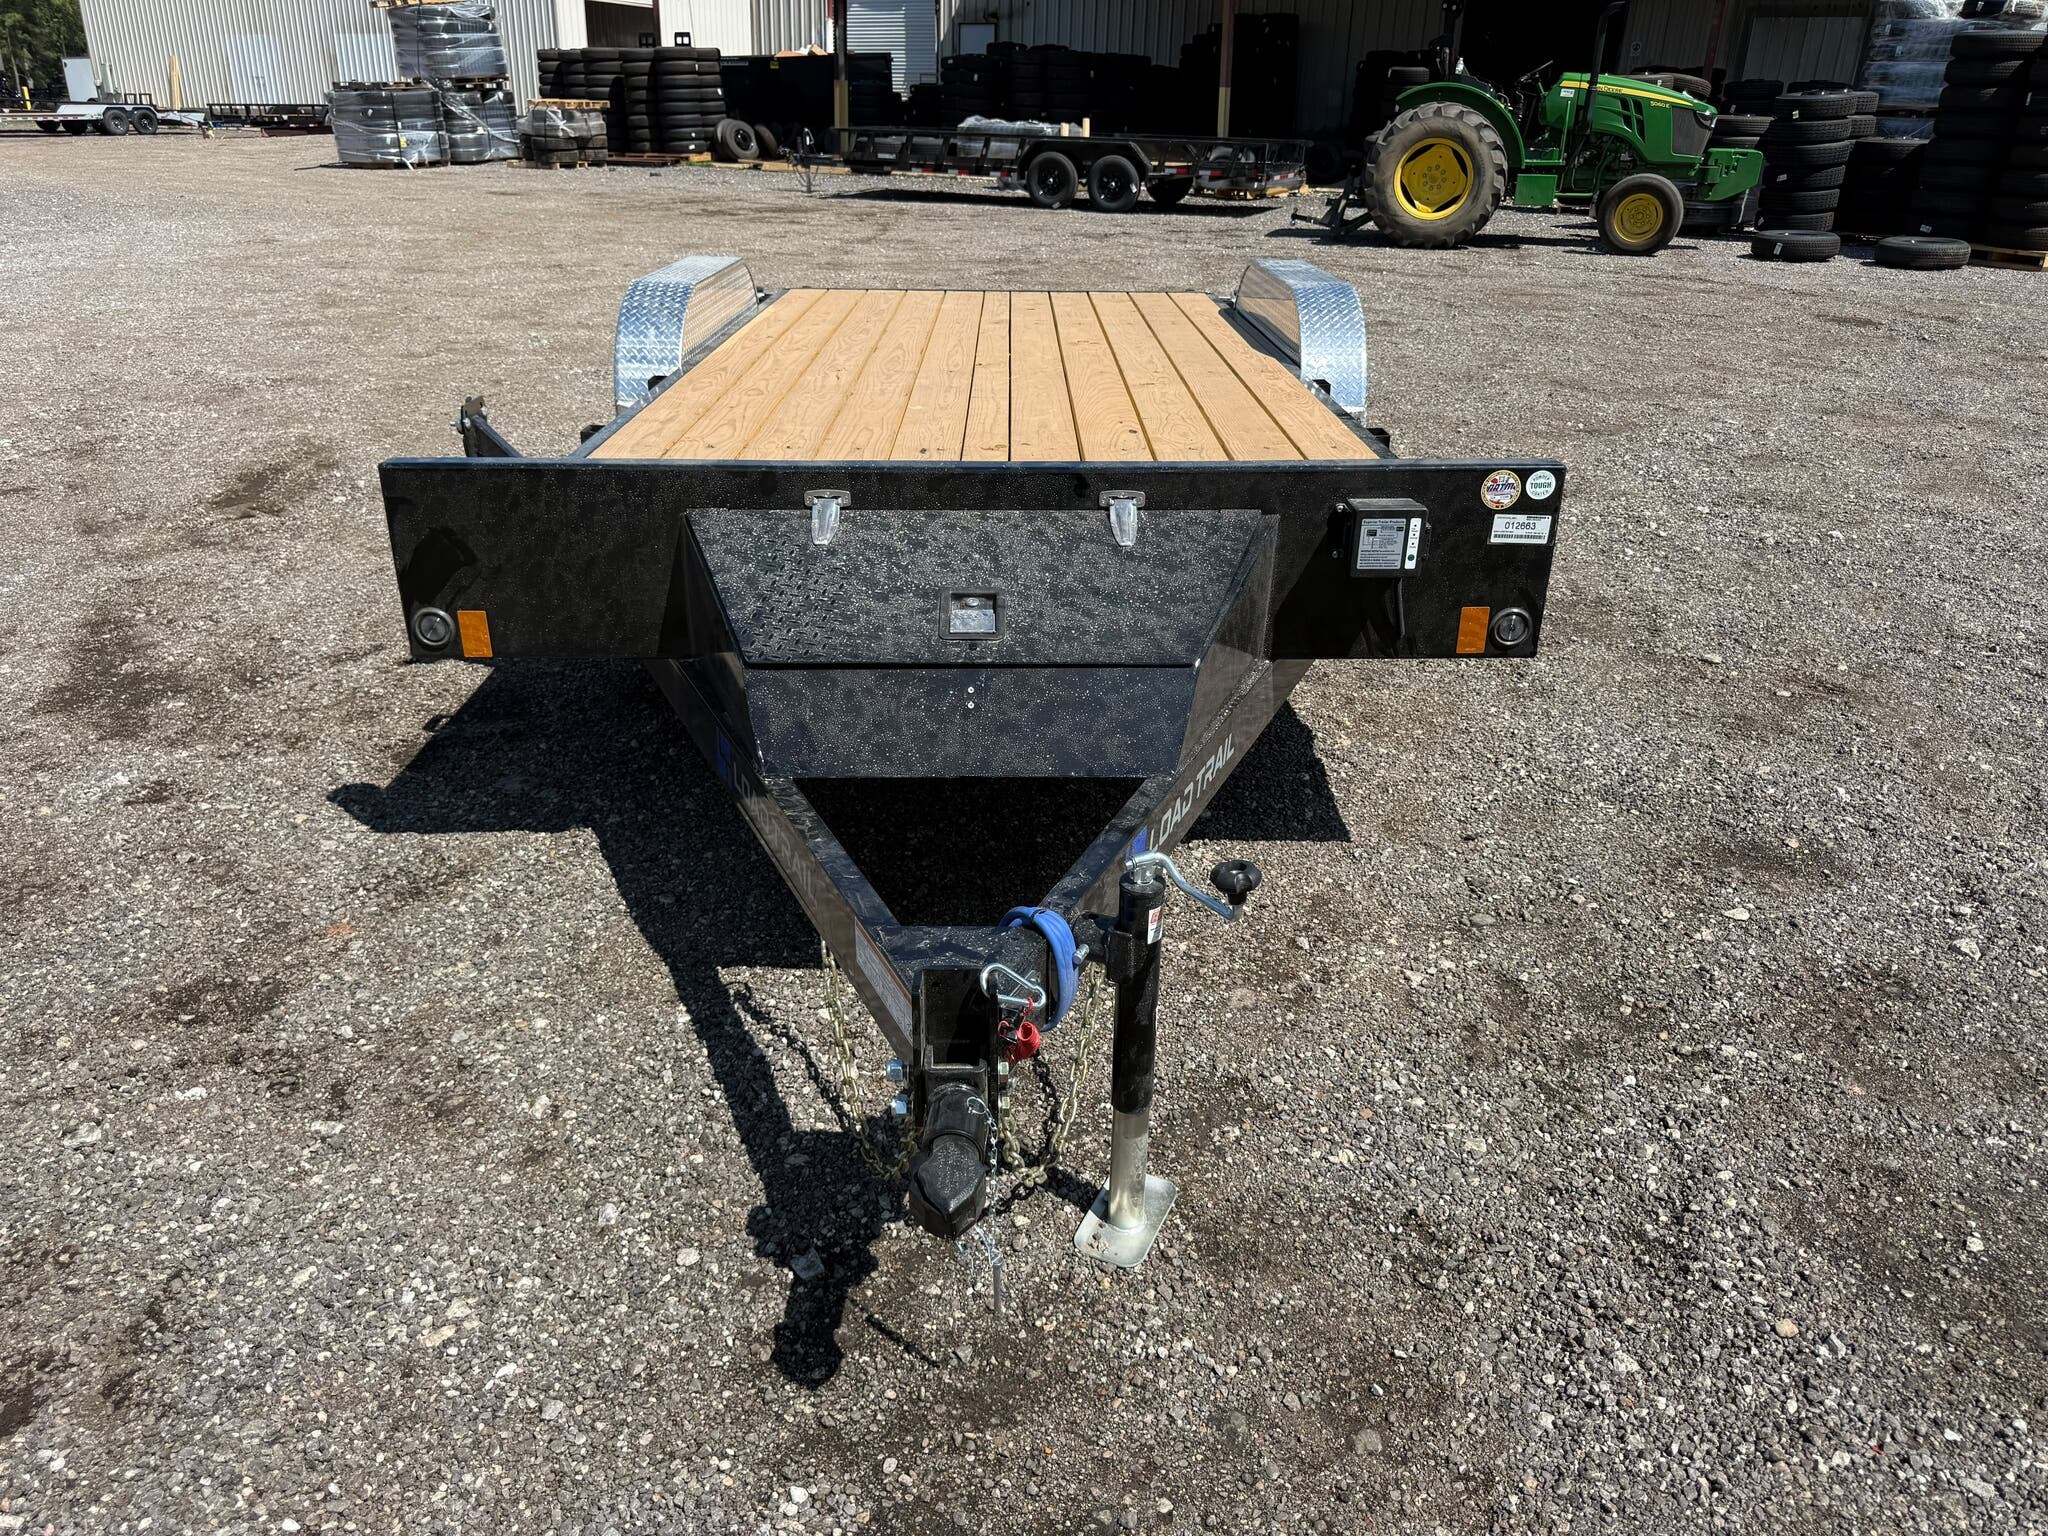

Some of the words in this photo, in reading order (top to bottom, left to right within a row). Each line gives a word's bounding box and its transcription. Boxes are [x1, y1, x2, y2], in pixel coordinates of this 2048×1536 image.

[1504, 521, 1537, 530] 012663
[1149, 781, 1194, 853] LOAD
[1195, 733, 1235, 799] TRAIL
